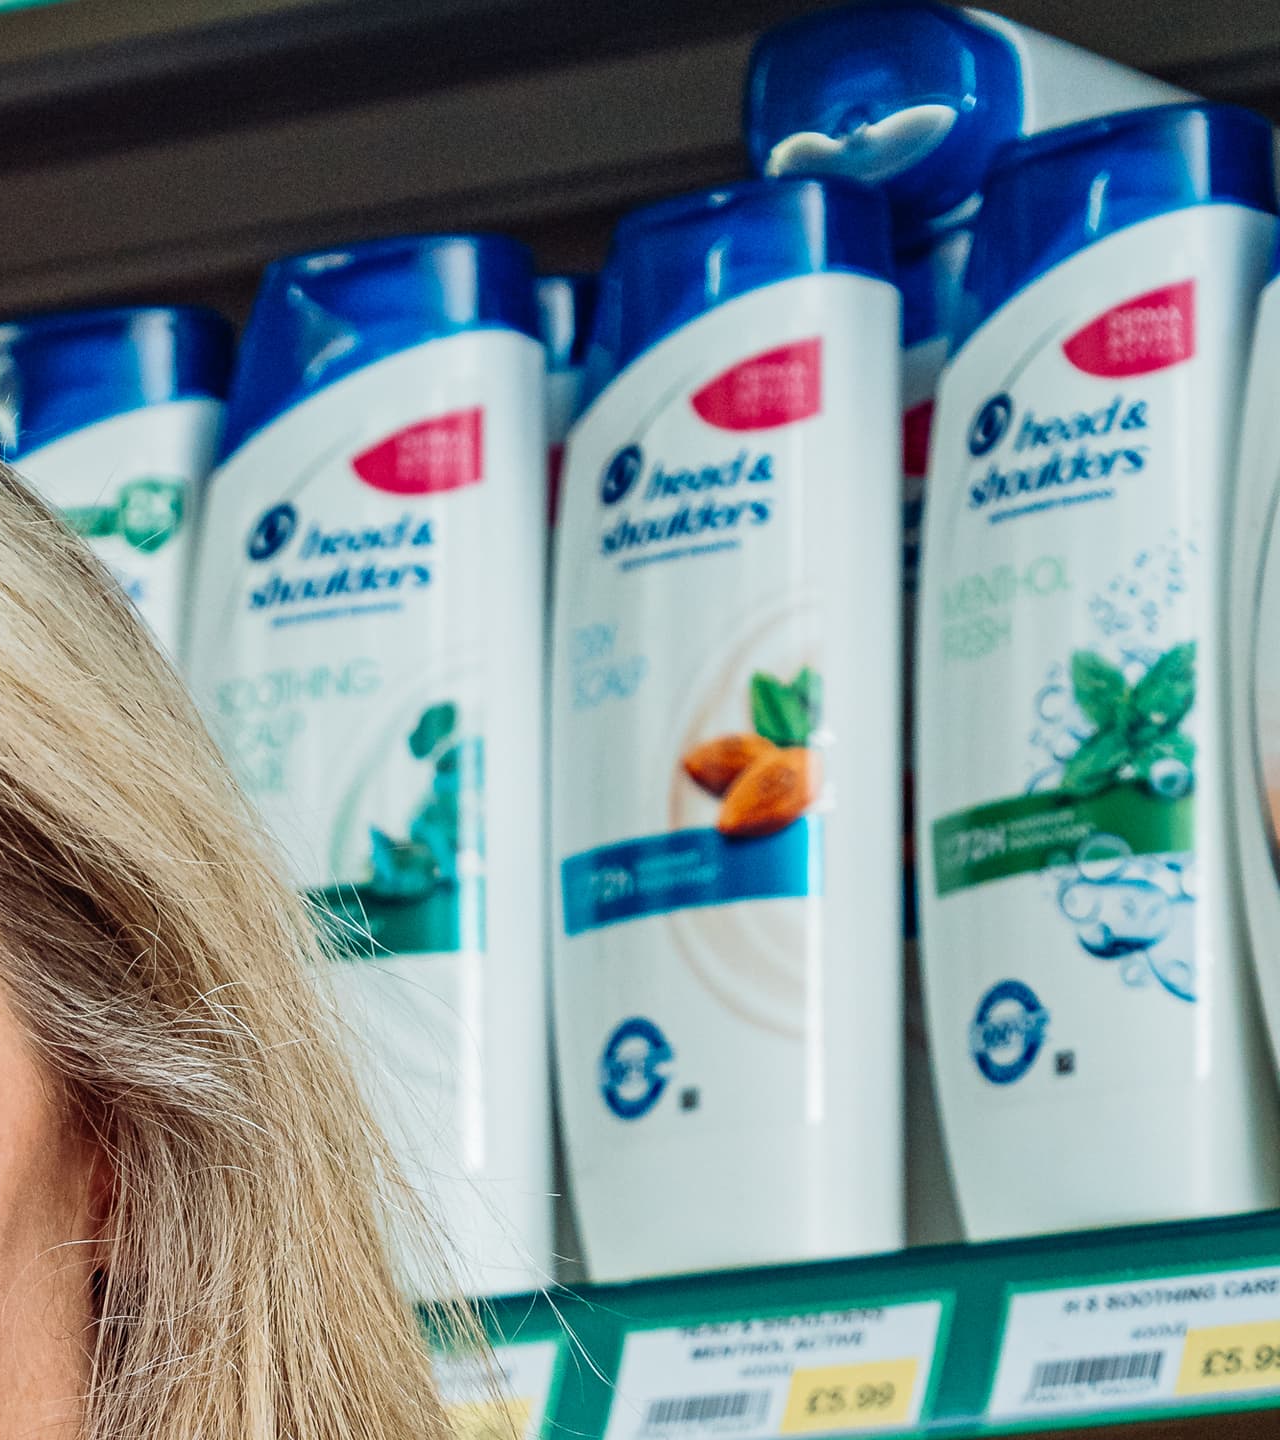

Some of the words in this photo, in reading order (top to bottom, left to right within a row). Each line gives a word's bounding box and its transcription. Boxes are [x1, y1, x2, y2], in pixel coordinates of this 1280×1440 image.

[1016, 396, 1122, 452] head
[969, 447, 1146, 510] shoulders
[601, 500, 772, 556] shoulders
[1105, 1283, 1216, 1311] SOOTHING
[806, 1381, 896, 1416] £5.99
